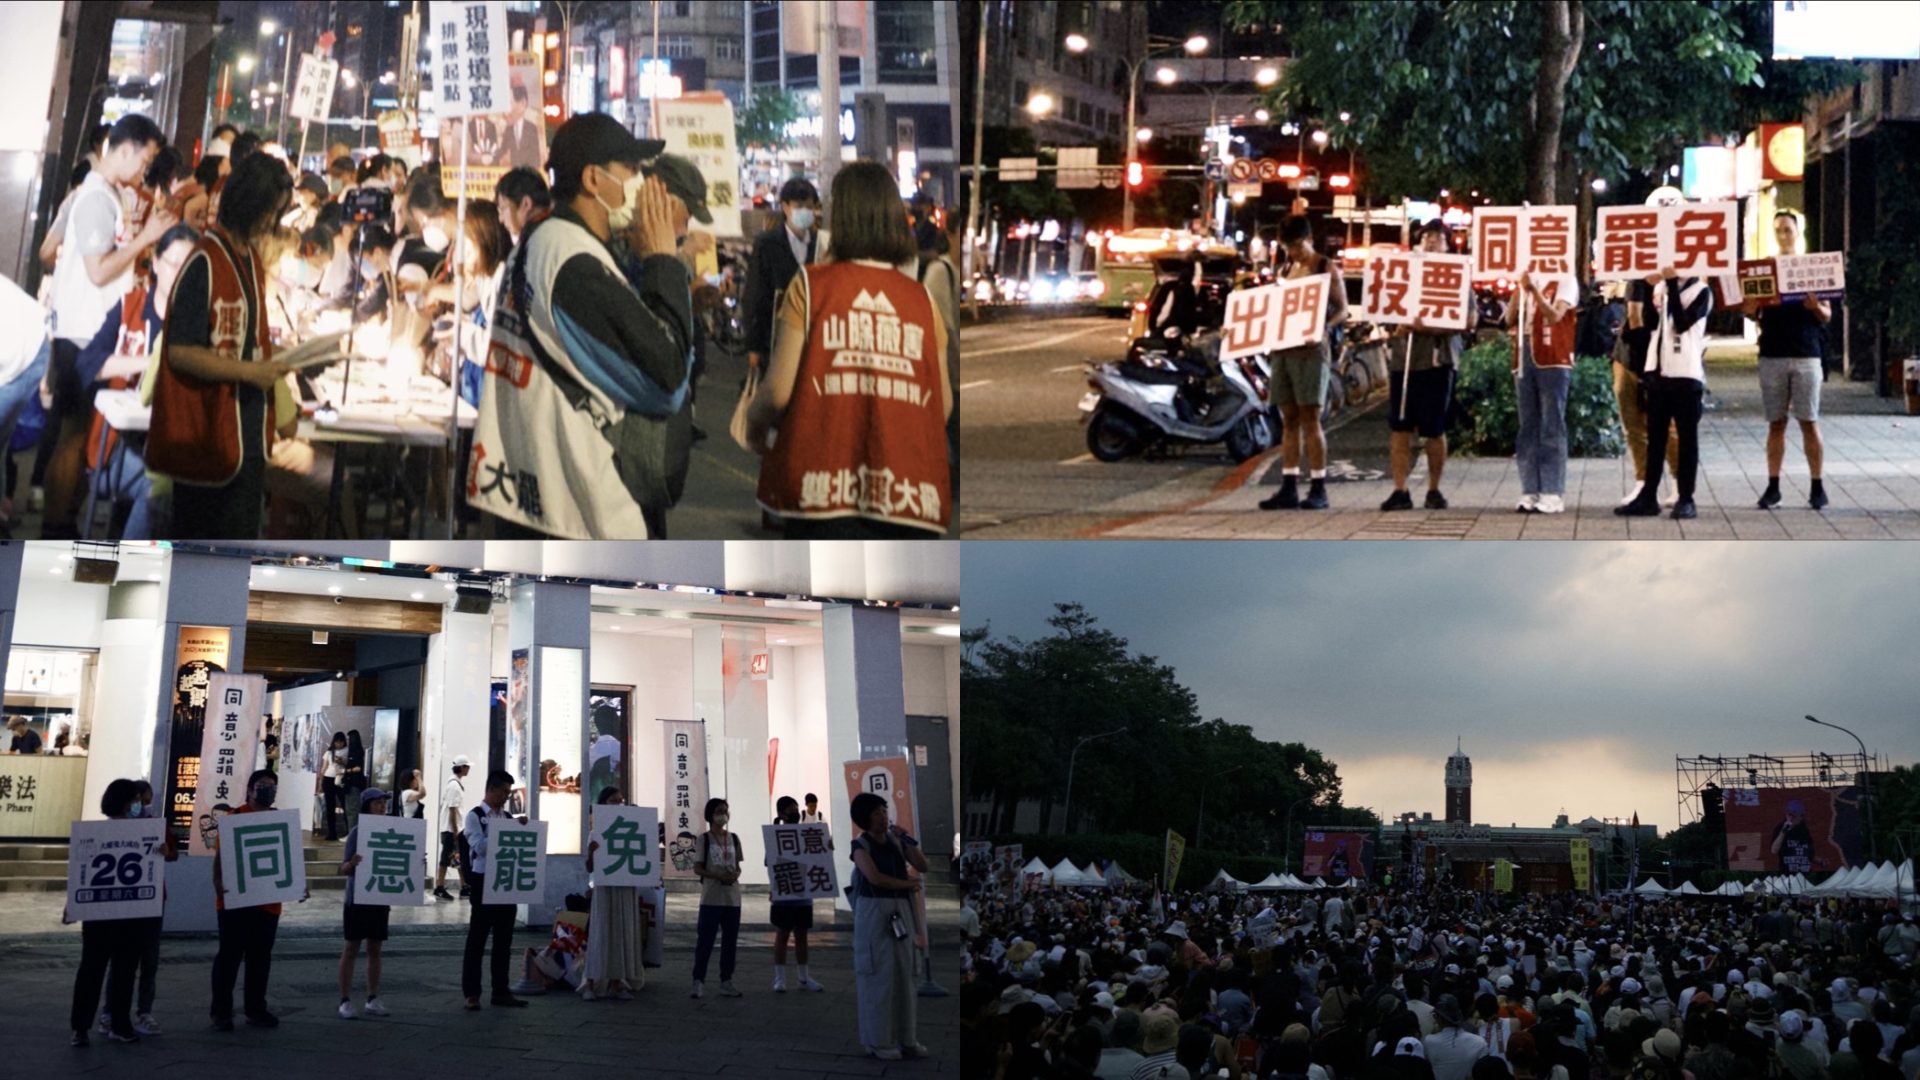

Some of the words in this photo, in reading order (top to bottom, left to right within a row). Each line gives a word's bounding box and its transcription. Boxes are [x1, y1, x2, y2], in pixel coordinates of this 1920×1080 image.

[465, 5, 492, 109] 現場填寫
[1478, 214, 1569, 274] 同意
[1604, 211, 1729, 273] 罷免
[1228, 282, 1322, 353] 出門
[1368, 257, 1464, 321] 投票
[215, 688, 243, 800] 同意罷免
[675, 733, 690, 829] 同意罷免
[870, 773, 888, 793] 同
[90, 852, 143, 887] 26
[233, 822, 293, 894] 同
[364, 828, 416, 893] 意
[492, 830, 538, 893] 罷
[602, 815, 652, 876] 免
[775, 827, 828, 856] 同意
[773, 861, 834, 896] 罷免
